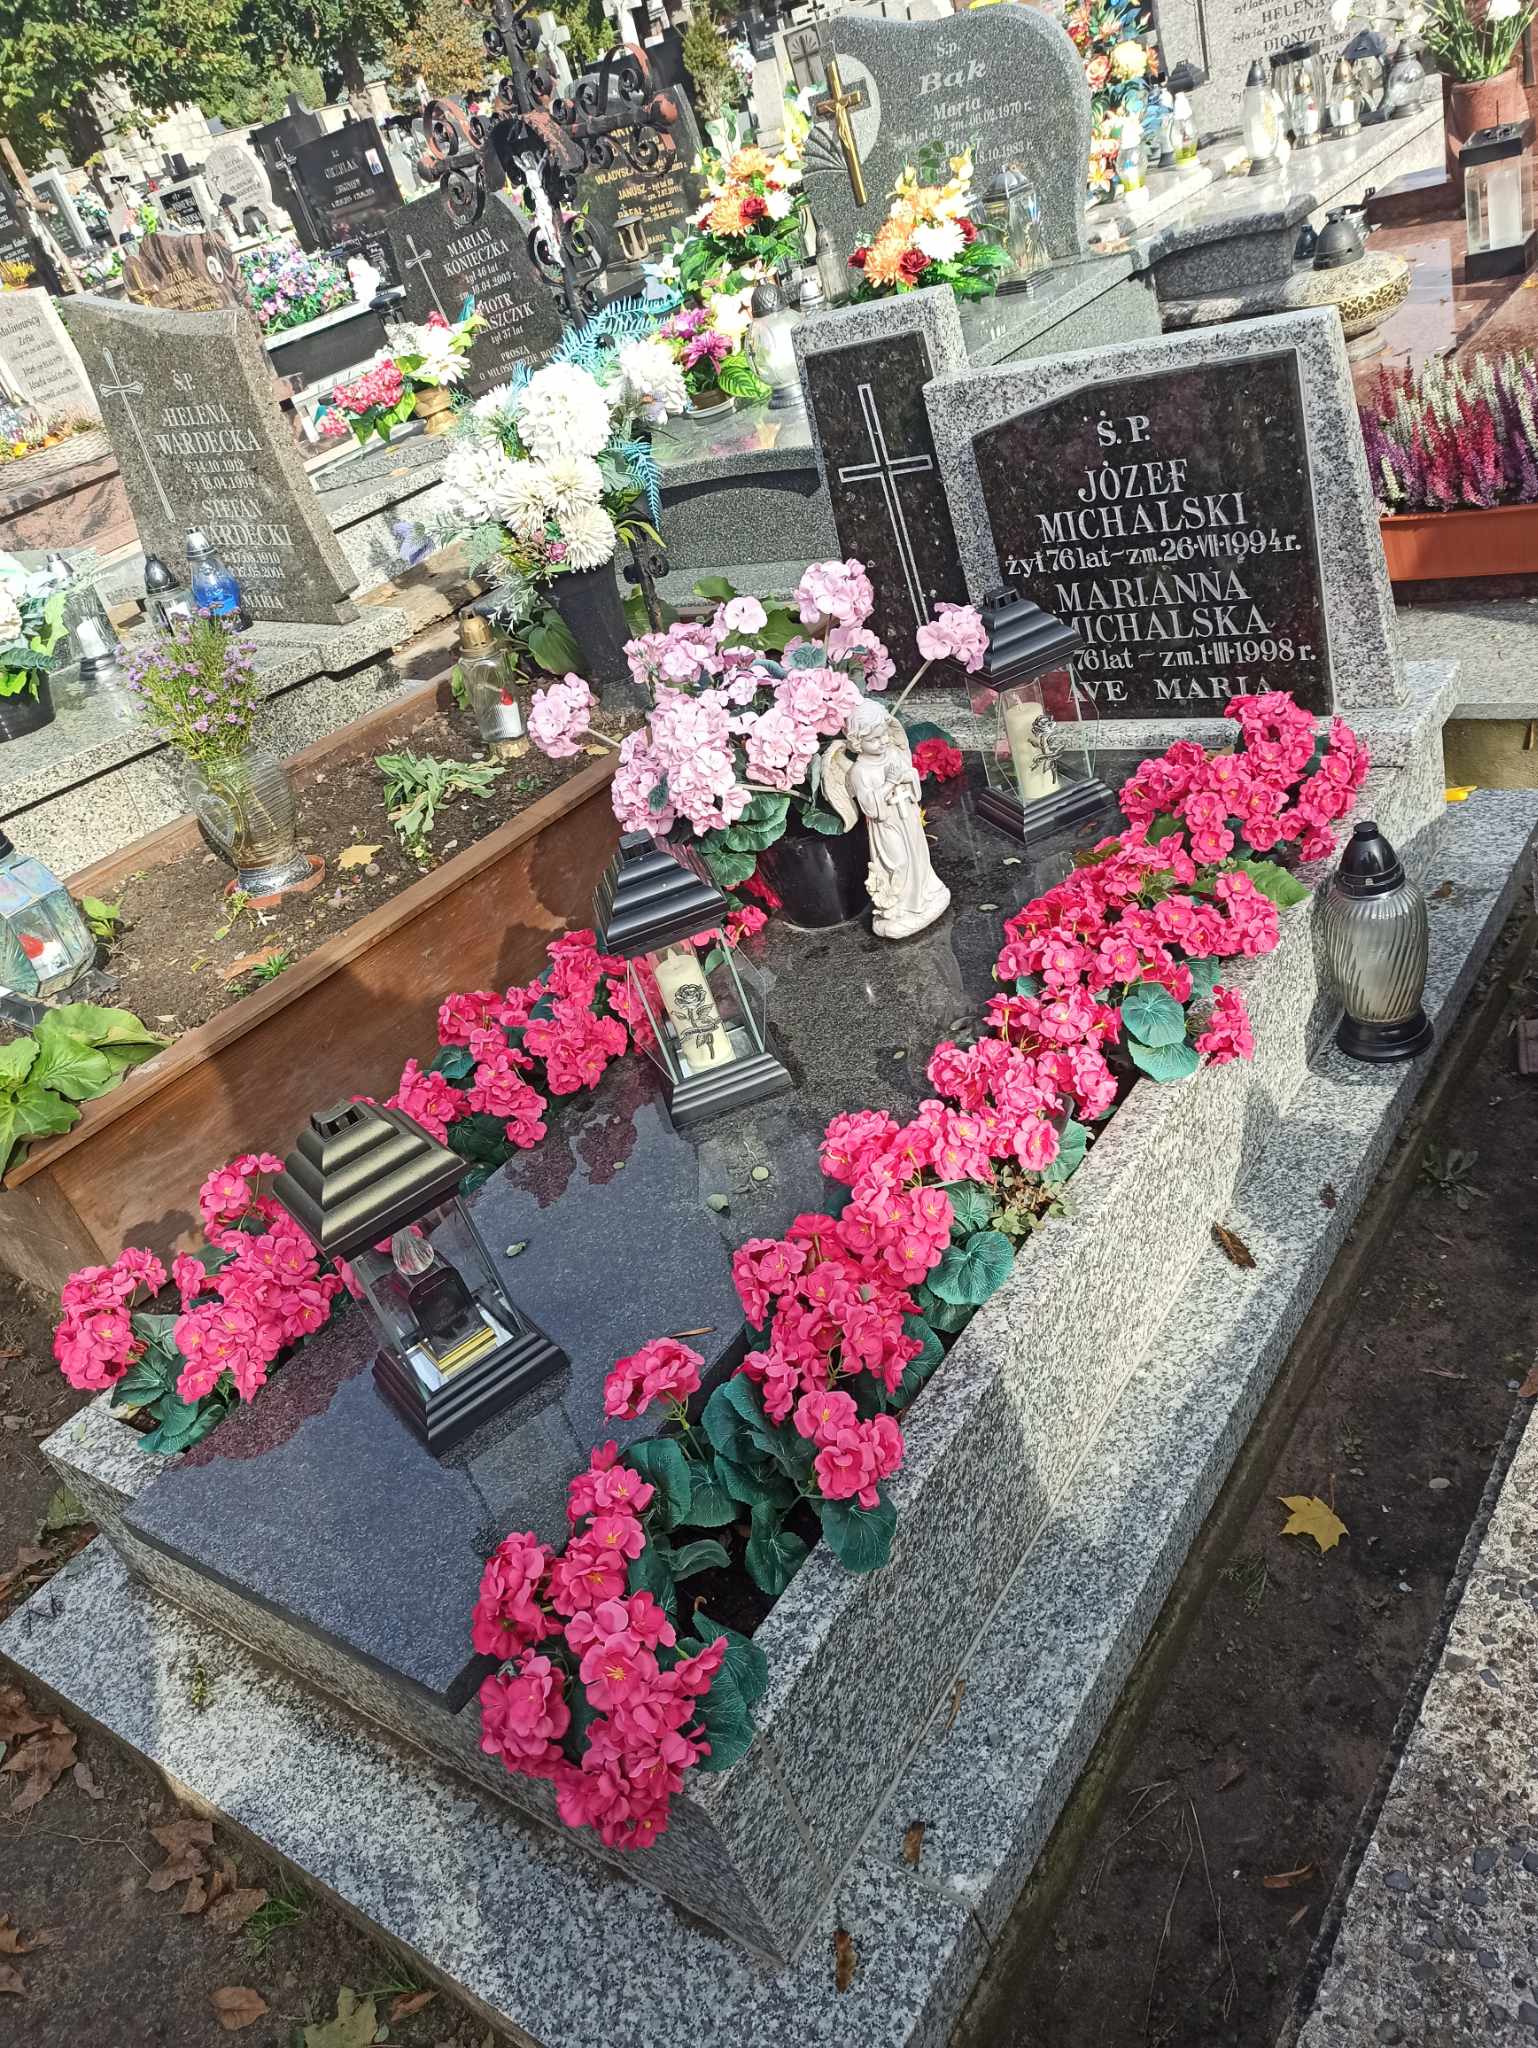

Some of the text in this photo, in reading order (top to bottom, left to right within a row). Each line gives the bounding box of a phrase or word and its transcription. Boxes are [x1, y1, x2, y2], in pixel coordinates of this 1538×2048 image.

[916, 58, 987, 98] Bak
[932, 95, 982, 121] Maria
[446, 227, 493, 258] MARIAN
[163, 403, 233, 428] HELENA
[1077, 458, 1189, 503] JÓZEF
[202, 498, 264, 519] STEFAN
[1035, 491, 1250, 544] MICHALSKI
[1054, 569, 1252, 614] MARIANNA
[1102, 647, 1134, 669] lat
[1067, 675, 1275, 704] AVE MARIA
